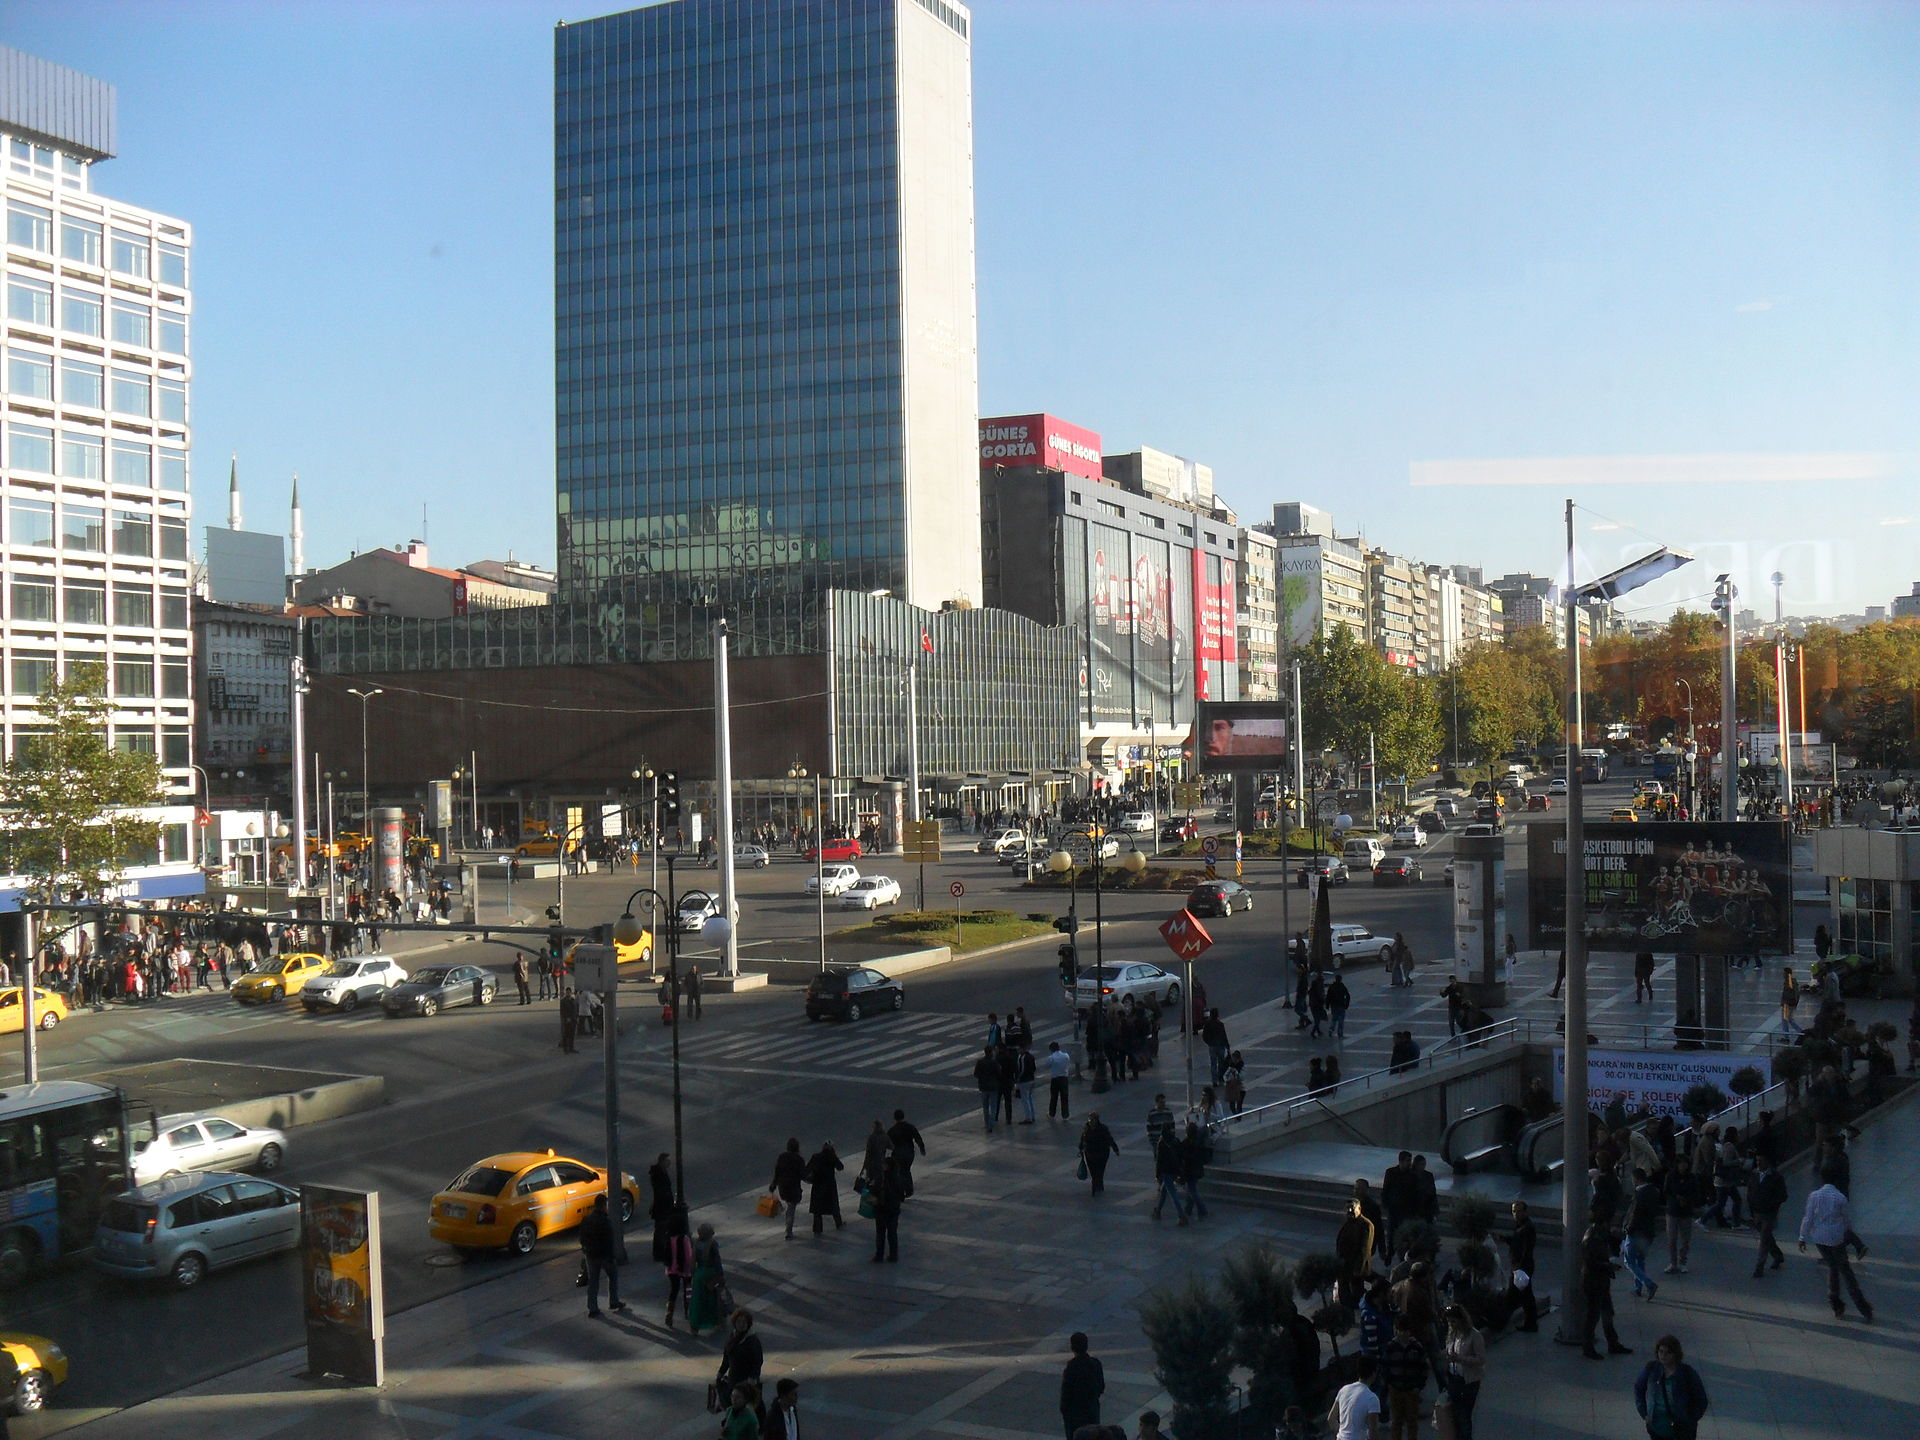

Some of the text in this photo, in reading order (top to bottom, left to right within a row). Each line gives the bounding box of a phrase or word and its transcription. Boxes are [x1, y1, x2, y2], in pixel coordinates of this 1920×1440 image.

[981, 442, 1037, 458] GORTA
[1048, 433, 1100, 464] GÜNEŞ SİGORTA
[1283, 559, 1321, 572] KAYRA
[1584, 840, 1632, 855] ASKETBOLU
[1634, 837, 1655, 857] İÇİN
[1584, 854, 1628, 870] ÖRT DEFA:
[1168, 920, 1187, 935] M
[1182, 939, 1201, 953] M
[1587, 1060, 1731, 1074] NKARA'NIN BAŞKENT OLUŞUNUN
